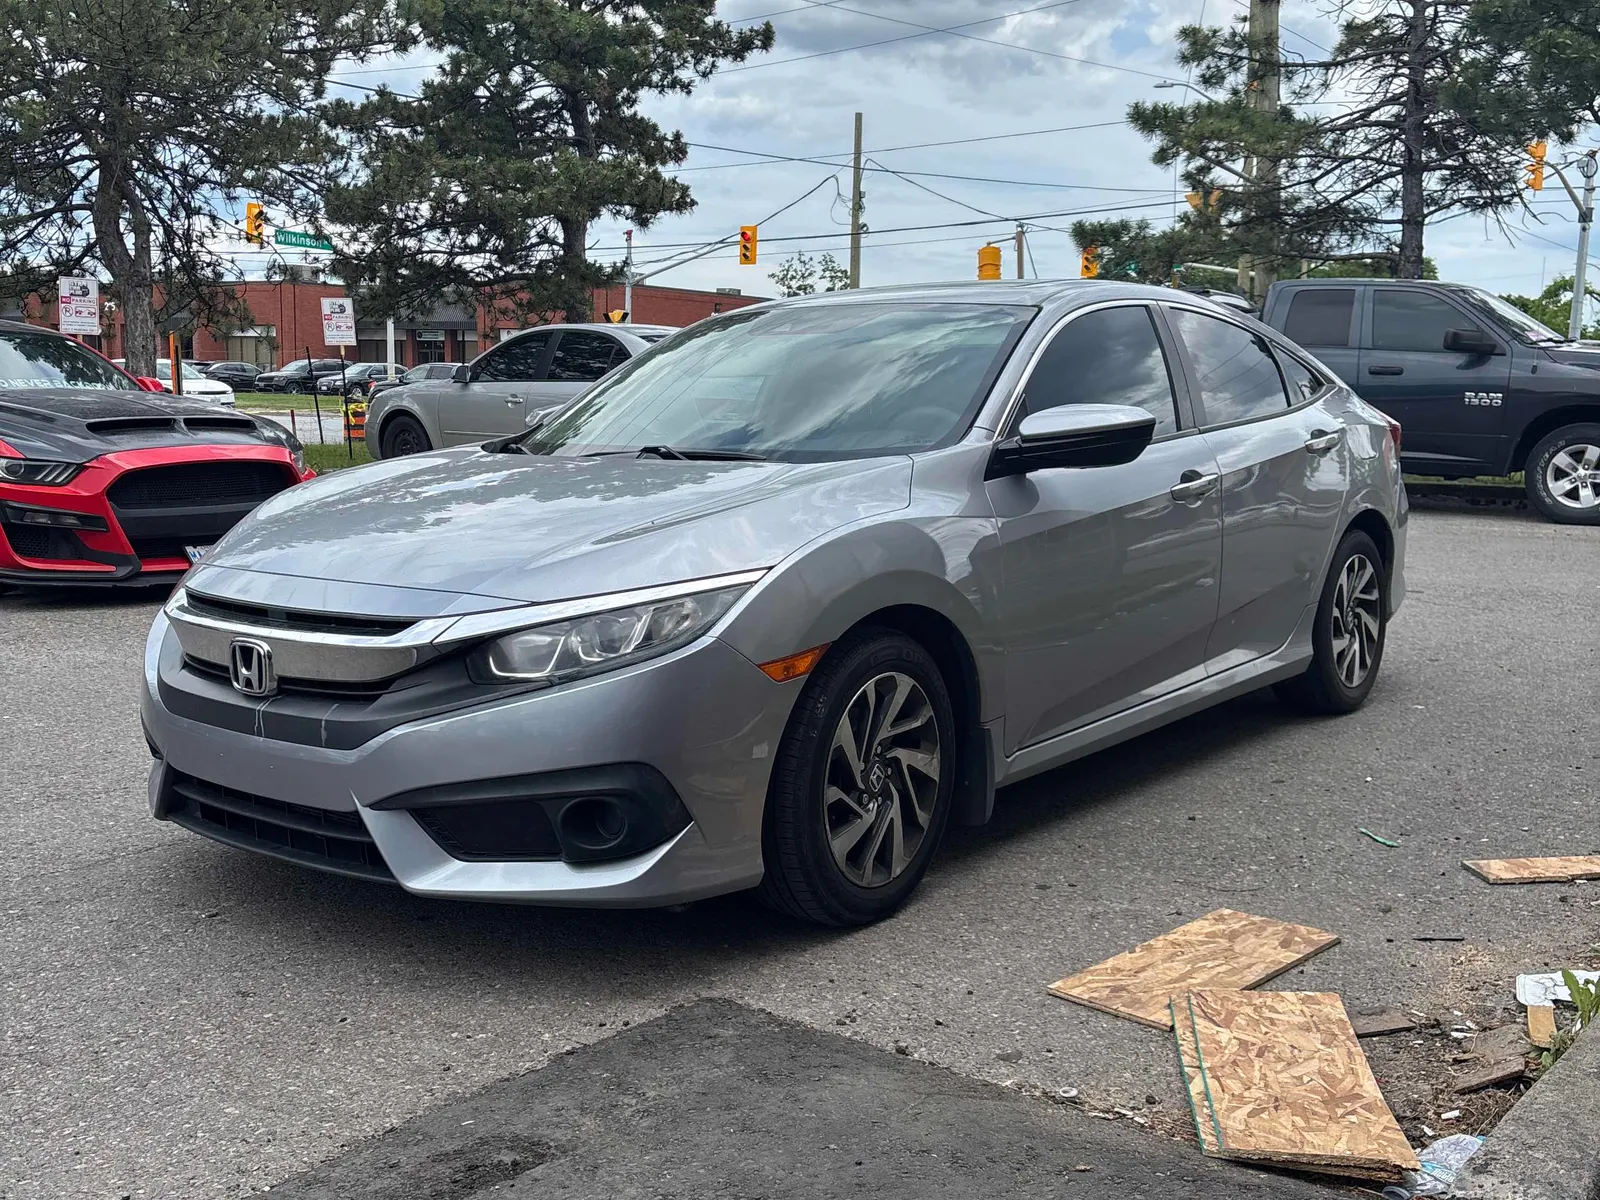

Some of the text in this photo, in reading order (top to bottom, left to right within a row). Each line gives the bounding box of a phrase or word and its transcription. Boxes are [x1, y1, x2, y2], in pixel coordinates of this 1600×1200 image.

[276, 231, 322, 248] Wilkinson
[12, 379, 53, 390] NEVER
[1464, 391, 1503, 400] RAM
[1464, 398, 1503, 407] 1500
